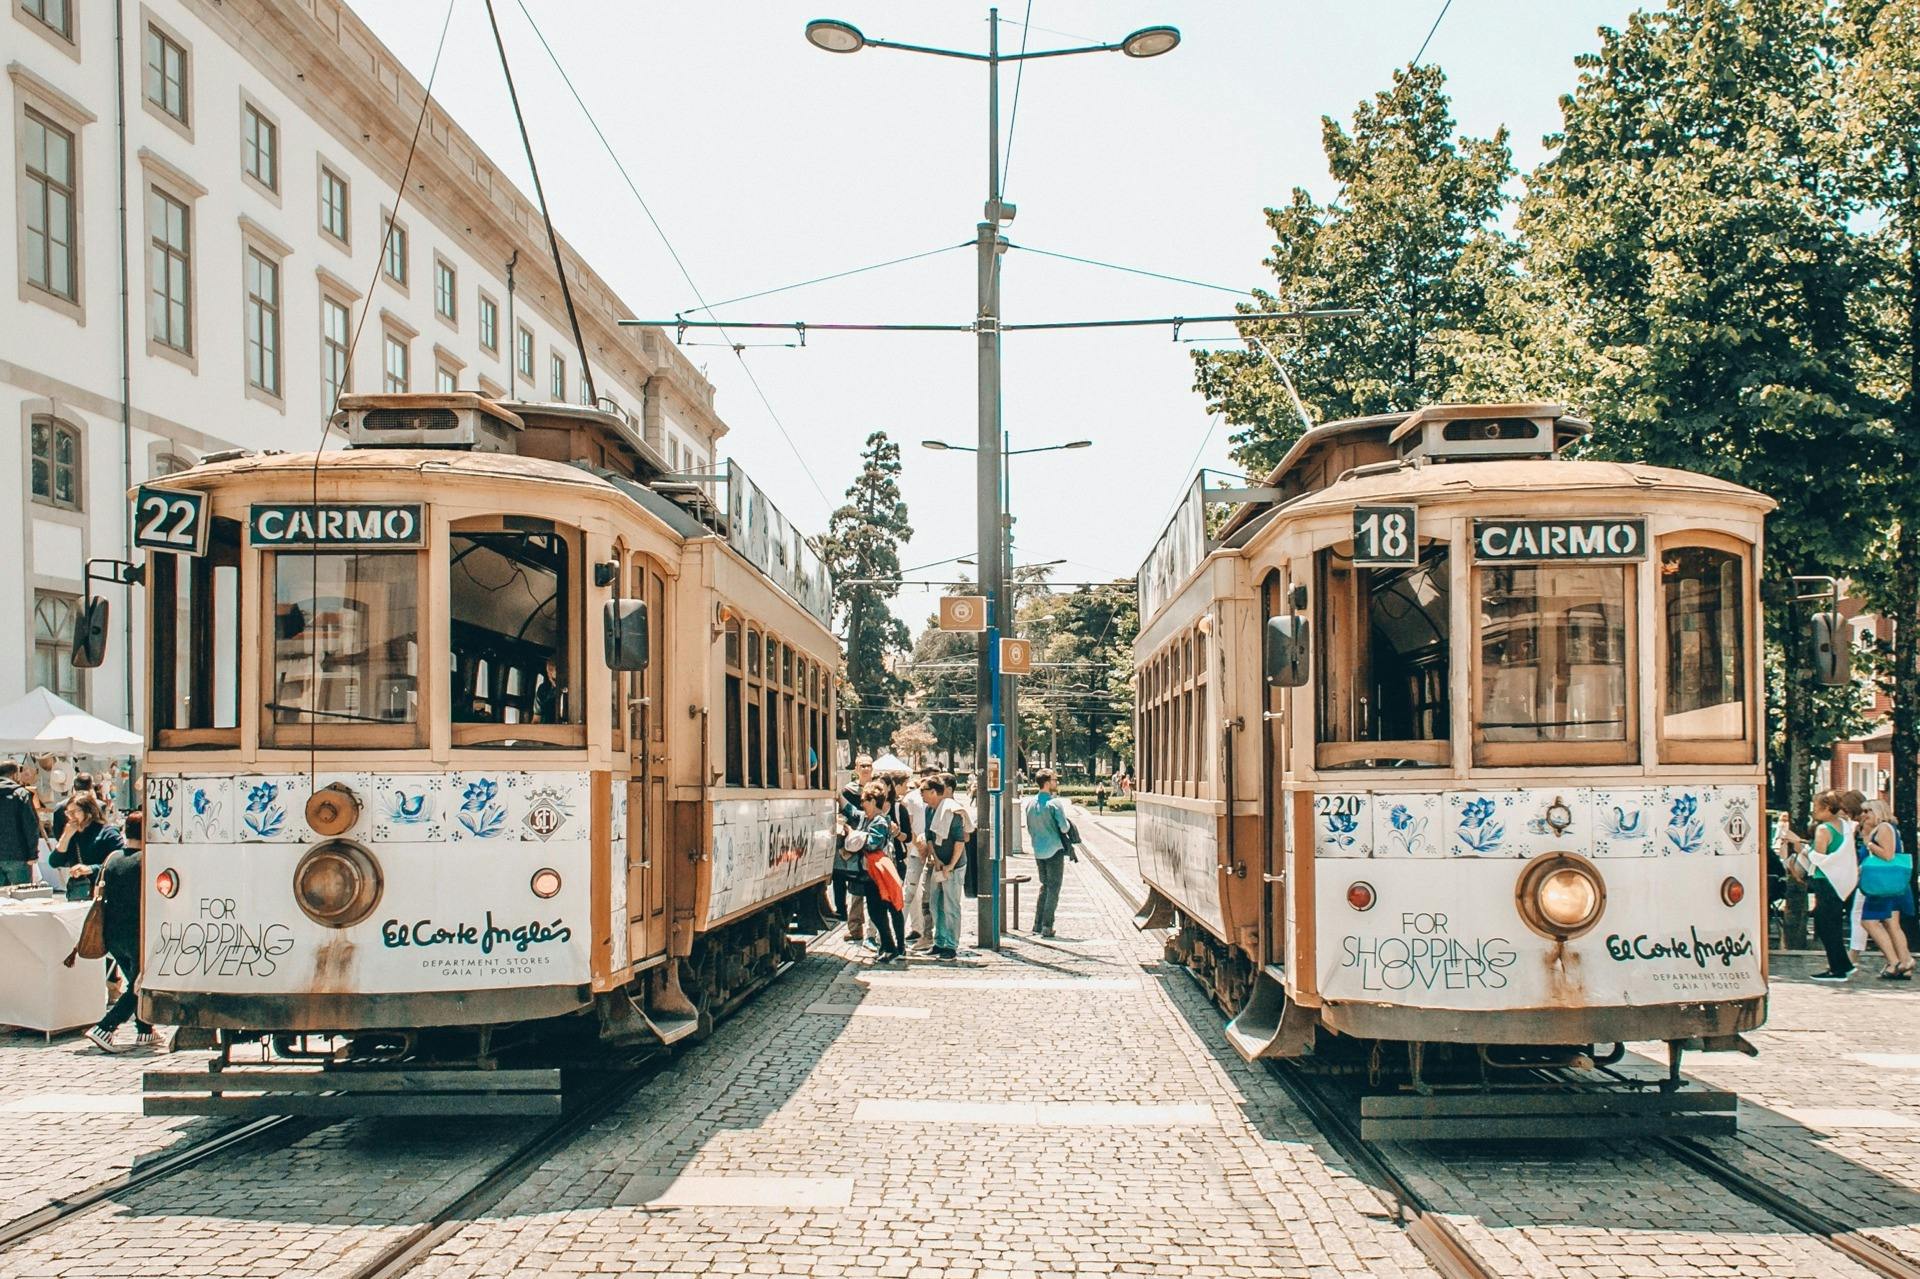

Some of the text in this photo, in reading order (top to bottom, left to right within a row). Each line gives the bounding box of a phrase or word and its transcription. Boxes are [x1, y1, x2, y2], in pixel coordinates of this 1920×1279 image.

[139, 496, 196, 544] 22
[258, 509, 414, 540] CARMO
[1360, 513, 1408, 557] 18
[1481, 524, 1637, 556] CARMO
[149, 778, 174, 800] 218
[1320, 795, 1361, 816] 220
[201, 898, 236, 919] FOR
[1402, 912, 1448, 934] FOR
[156, 922, 295, 956] SHOPPING
[382, 911, 571, 954] El Corte Inglés
[158, 945, 282, 977] LOVERS
[422, 956, 551, 968] DEPARTMENT STORES
[1342, 936, 1517, 969] SHOPPING
[1606, 934, 1635, 961] El
[1633, 934, 1691, 960] Corte
[442, 968, 472, 976] GAIA
[491, 966, 532, 975] PORTO
[1363, 957, 1507, 990] LOVERS
[1652, 971, 1751, 982] DEPARTMENT STORES
[1672, 982, 1699, 990] GAIA
[1712, 981, 1740, 990] PORTO
